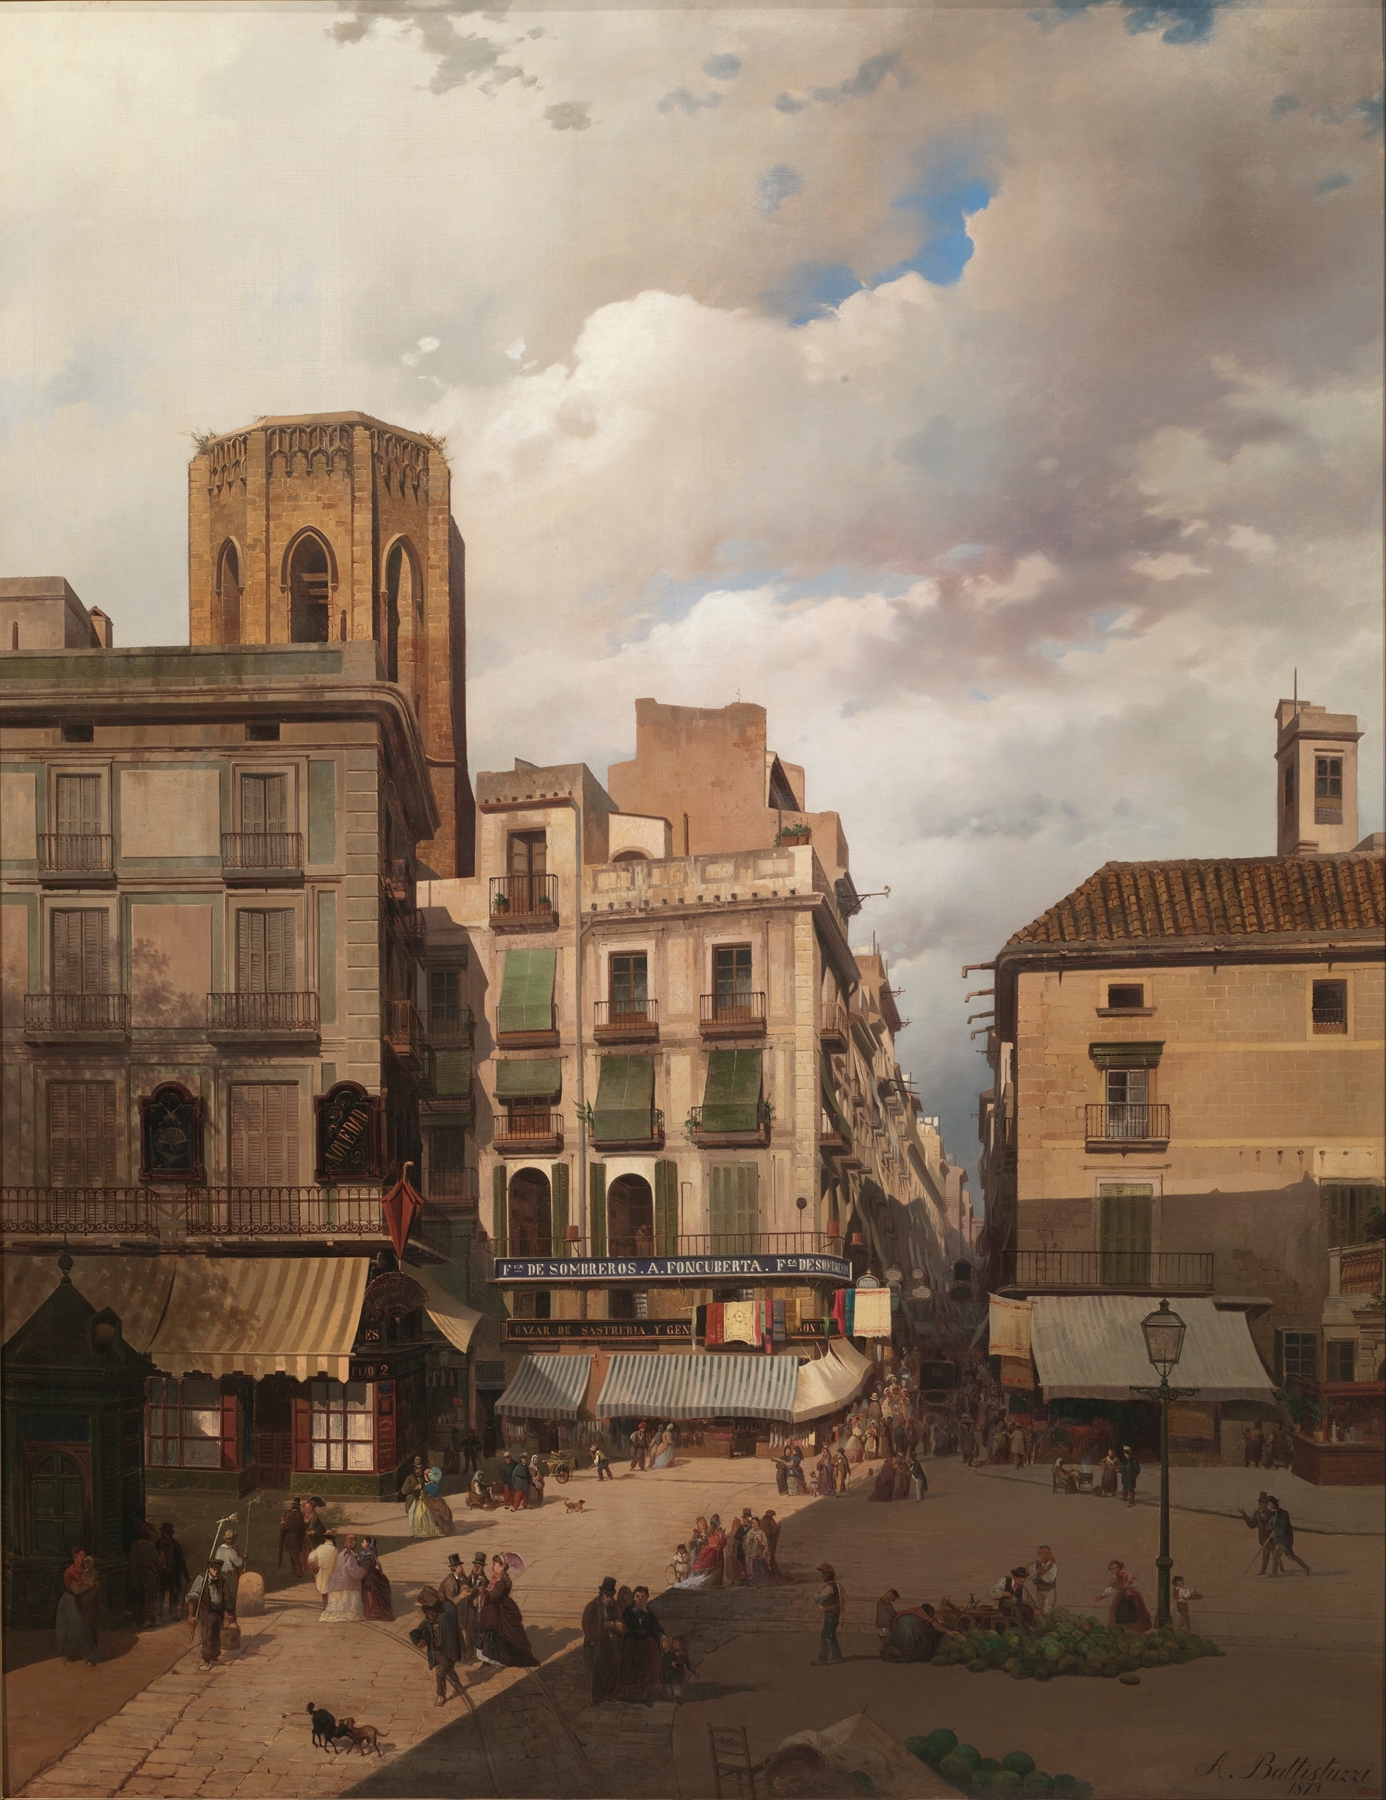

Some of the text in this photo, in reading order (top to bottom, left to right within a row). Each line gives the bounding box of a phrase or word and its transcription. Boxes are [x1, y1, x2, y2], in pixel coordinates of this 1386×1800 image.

[527, 1263, 544, 1276] DE
[798, 1258, 815, 1271] DE
[558, 1325, 571, 1335] DE
[654, 1325, 662, 1335] Y
[665, 1325, 692, 1335] GEN
[379, 1364, 389, 1377] 2
[1239, 1751, 1375, 1783] Battistuzzi
